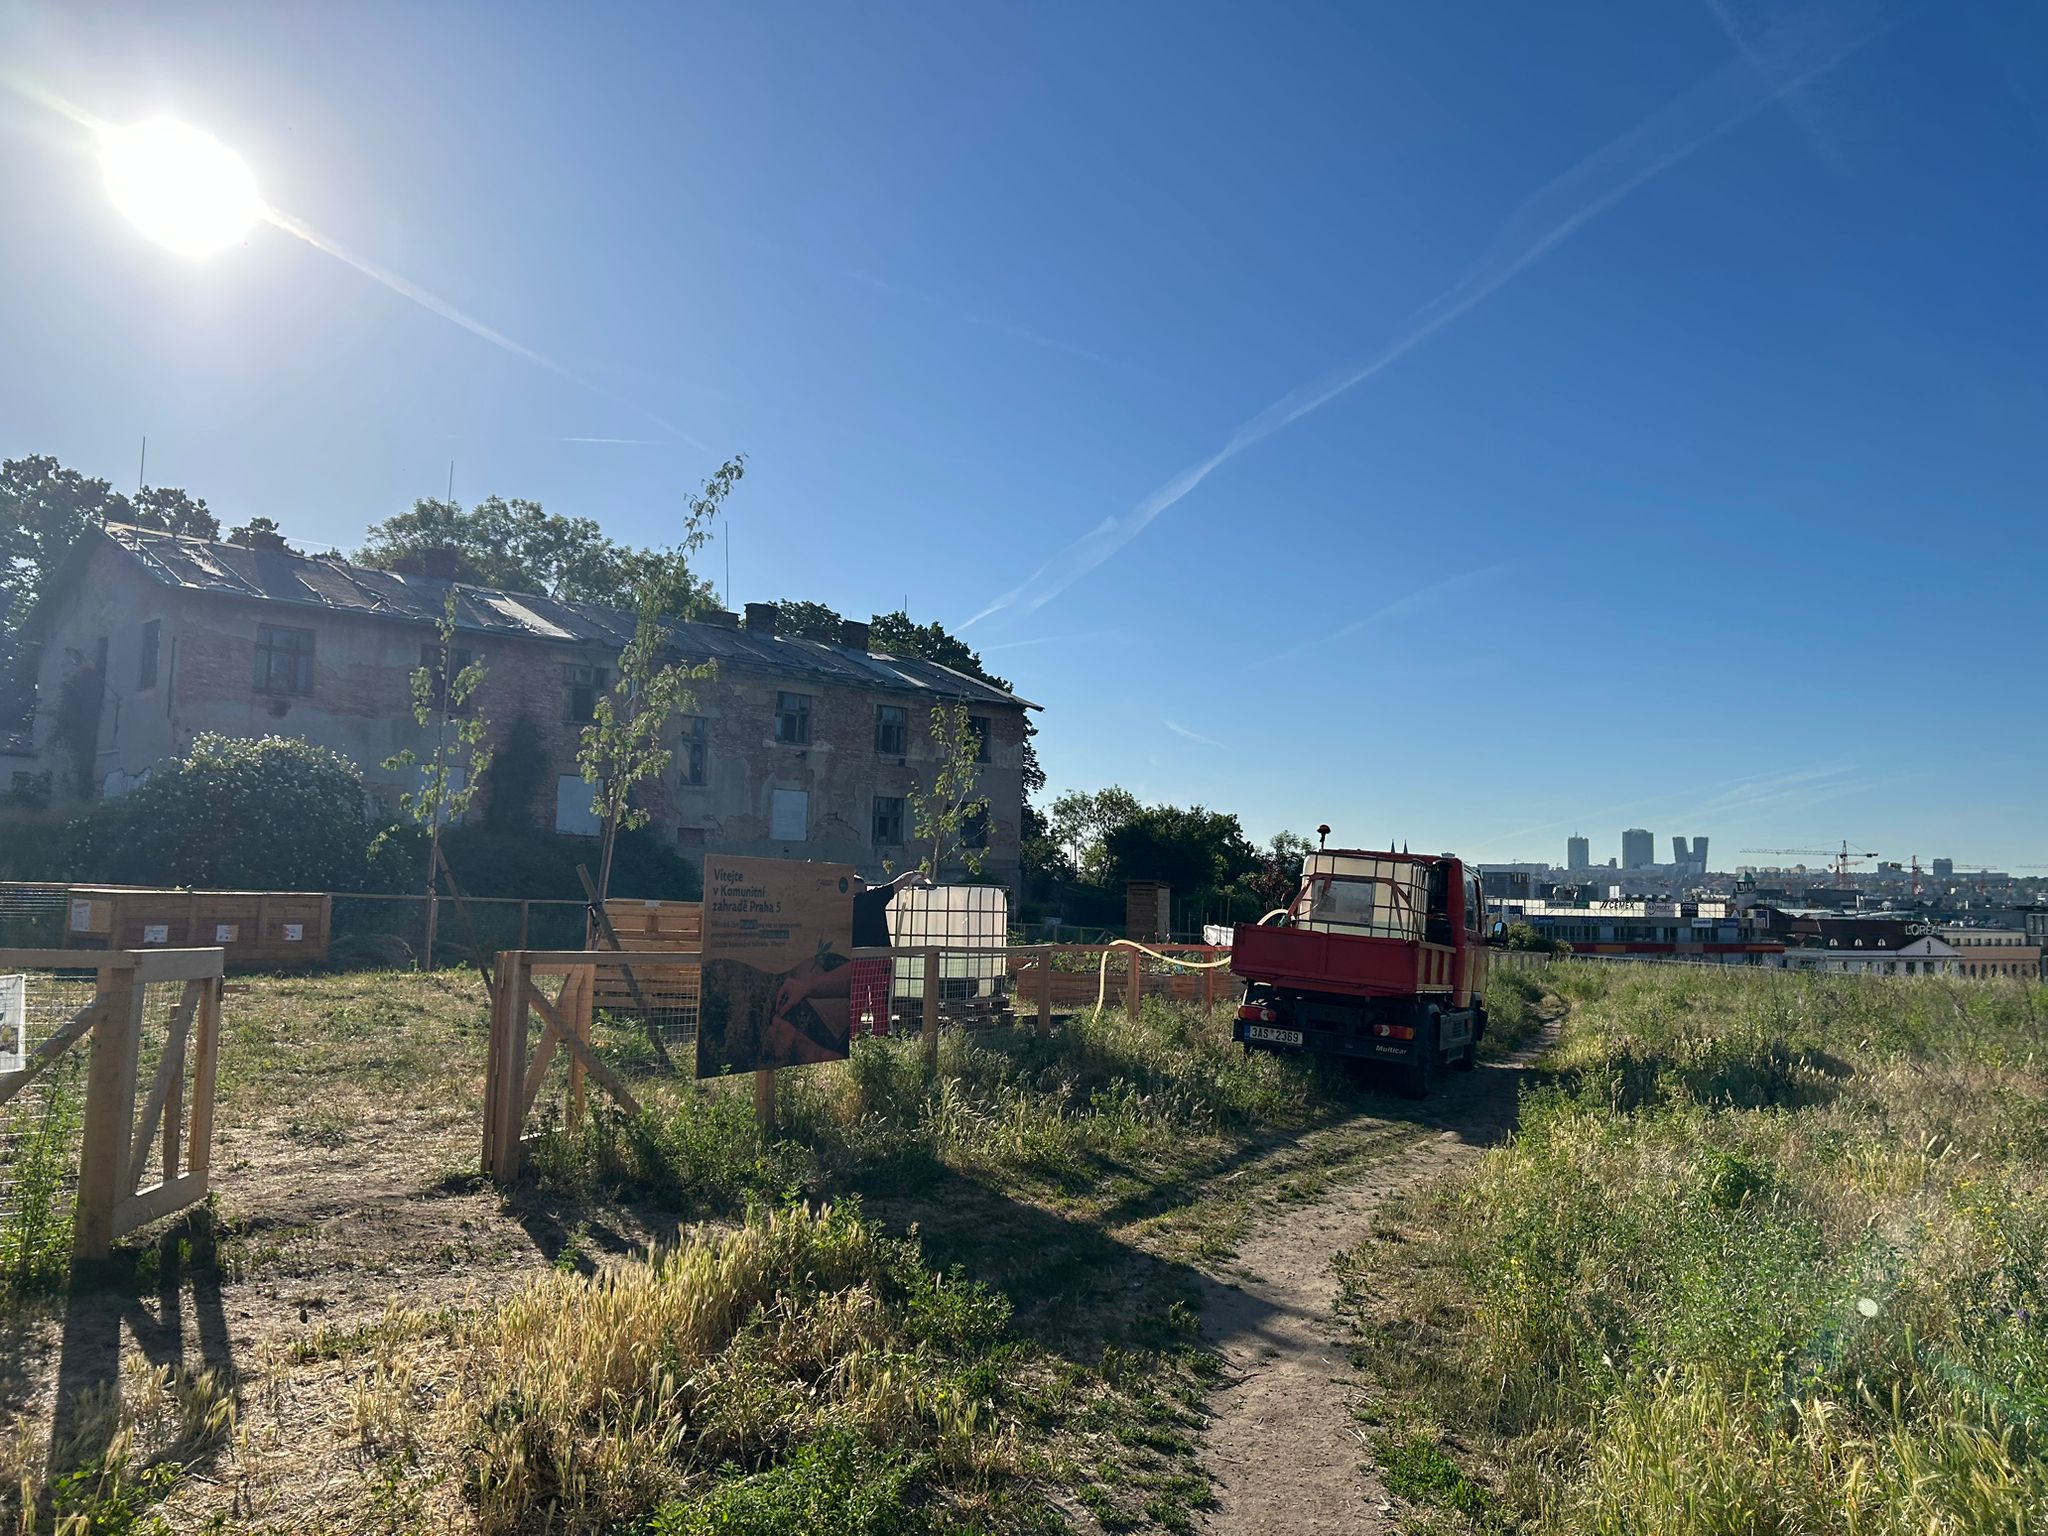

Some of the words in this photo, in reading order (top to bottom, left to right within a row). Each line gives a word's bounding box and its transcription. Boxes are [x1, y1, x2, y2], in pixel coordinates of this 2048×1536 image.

[714, 868, 743, 885] Vítejte
[713, 887, 719, 896] v
[720, 884, 766, 898] Komunitní
[712, 898, 748, 912] zahradě
[749, 901, 774, 913] Praha
[775, 901, 782, 913] 5
[1608, 901, 1635, 910] CEMEX
[1251, 1027, 1269, 1039] 3AS
[1275, 1030, 1299, 1043] 2369
[1375, 1044, 1407, 1055] Multicar
